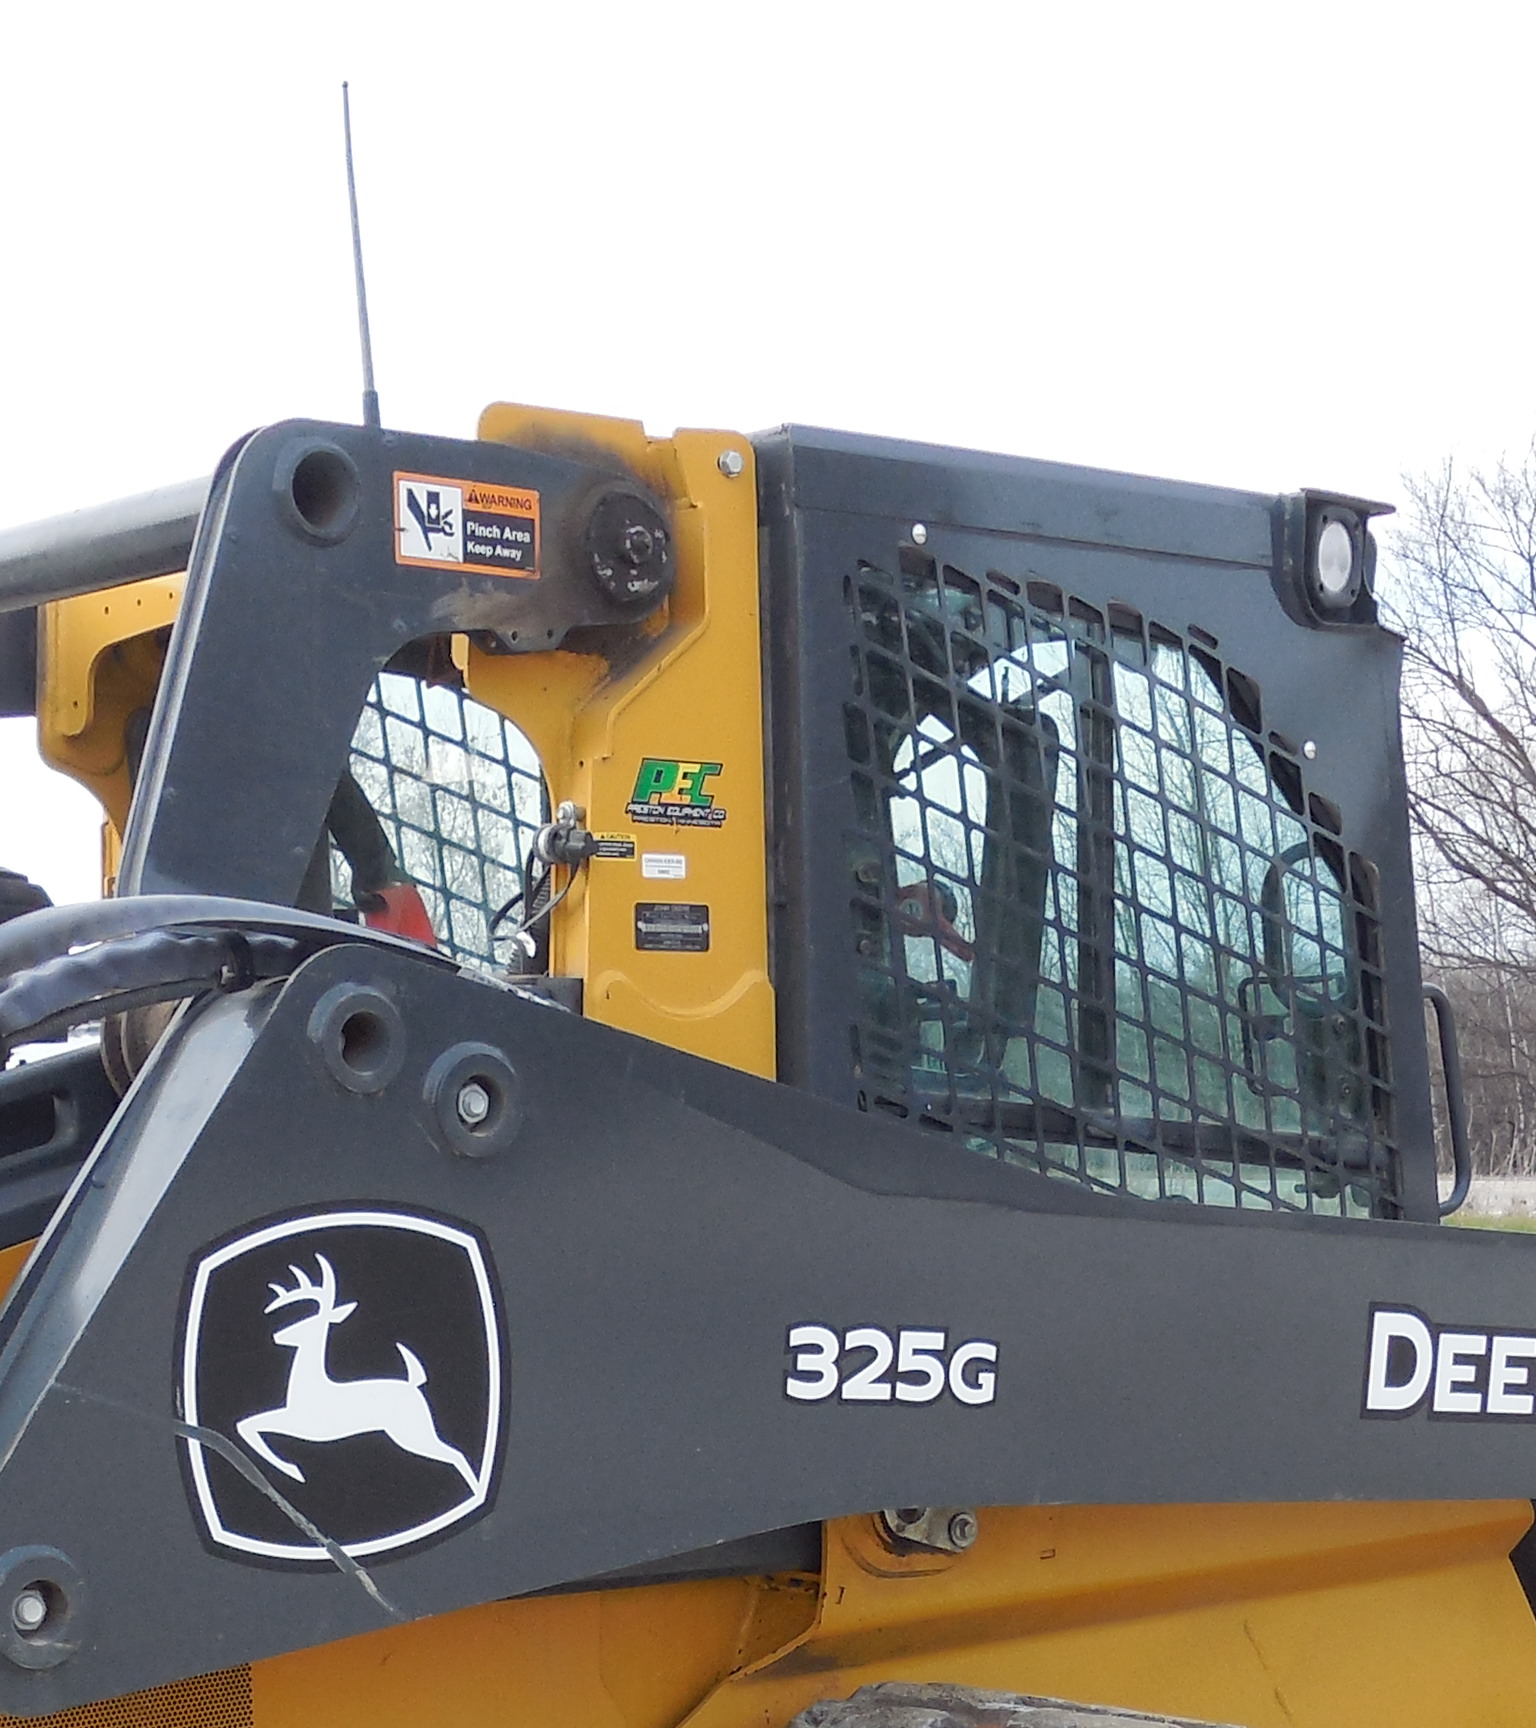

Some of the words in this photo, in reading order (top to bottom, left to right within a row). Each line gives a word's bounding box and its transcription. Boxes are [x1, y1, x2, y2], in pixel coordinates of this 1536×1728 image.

[480, 492, 532, 511] WARNING
[467, 521, 501, 539] Pinch
[503, 527, 531, 543] Area
[467, 541, 494, 558] Keep
[494, 545, 522, 562] Away
[632, 757, 723, 807] PEC
[627, 803, 665, 815] PRESTON
[786, 1326, 998, 1405] 325G
